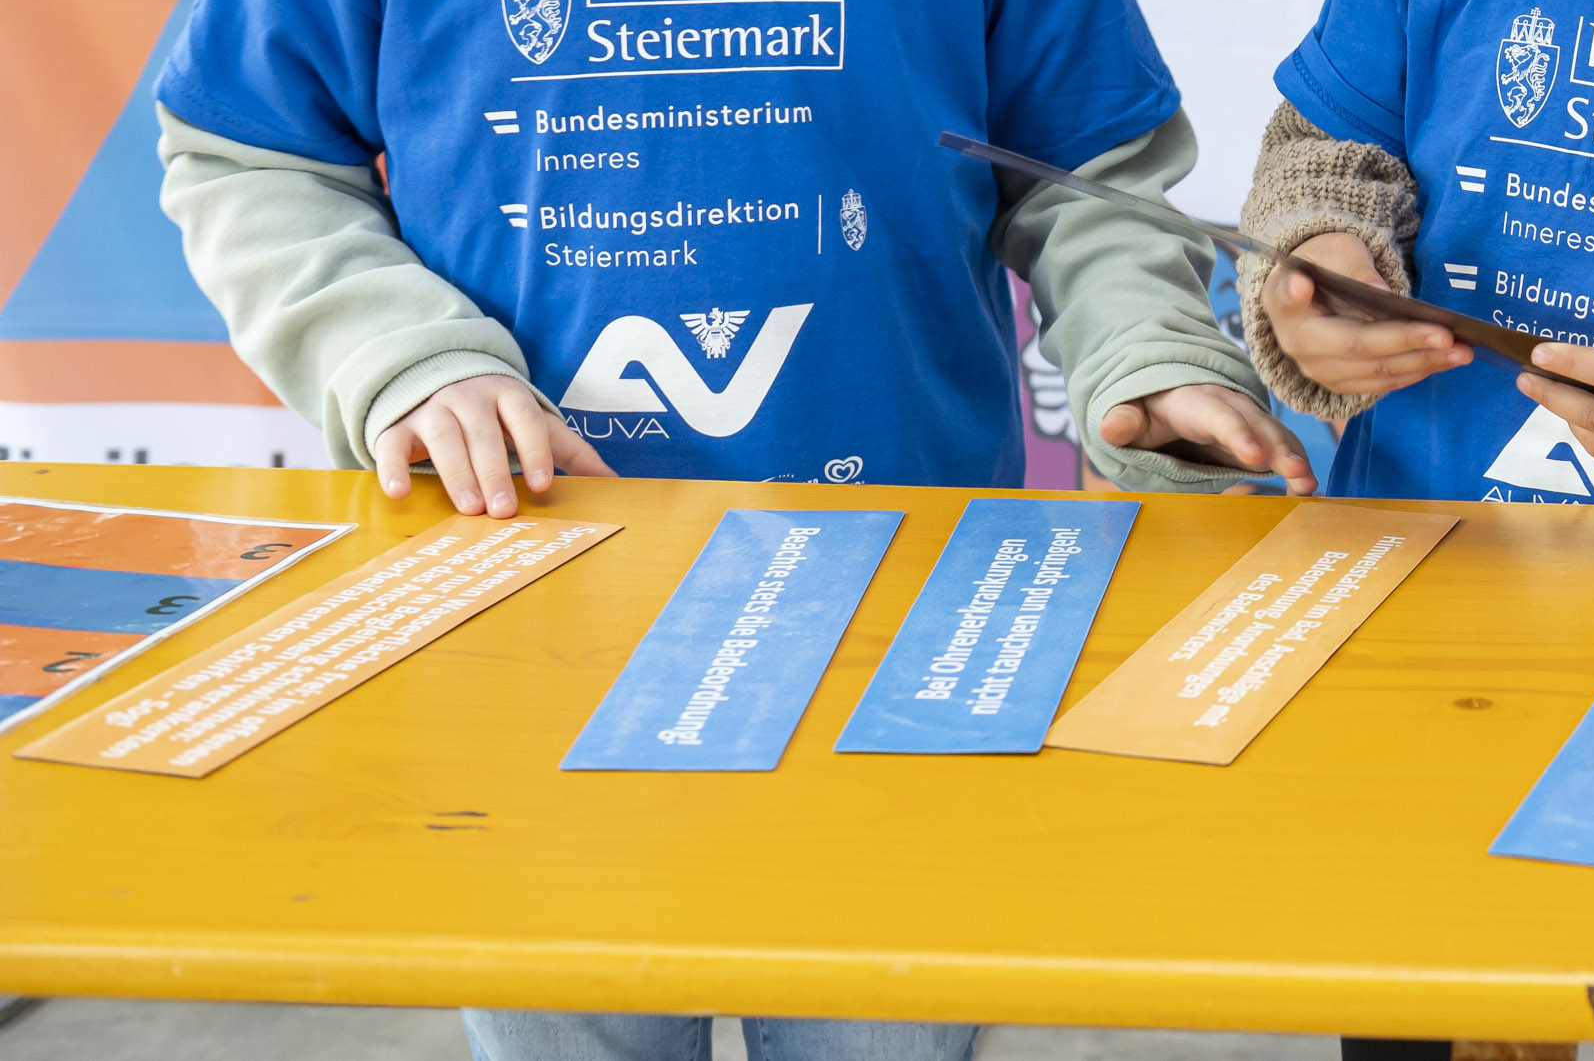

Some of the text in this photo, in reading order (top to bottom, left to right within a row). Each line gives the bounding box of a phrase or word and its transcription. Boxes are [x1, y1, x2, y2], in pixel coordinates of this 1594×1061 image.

[586, 14, 835, 62] Steiermark
[535, 102, 813, 134] Bundesministerium
[536, 148, 640, 171] Inneres
[539, 199, 799, 235] Bildungsdirektion
[545, 240, 698, 267] Steiermark
[566, 414, 670, 439] AUVA
[415, 535, 462, 556] und
[442, 522, 538, 564] Vermeide
[466, 539, 543, 574] Wasser
[505, 526, 596, 567] Sprünge,
[410, 565, 454, 583] das
[432, 574, 474, 593] nur
[458, 569, 520, 597] wenn
[1246, 573, 1283, 591] des
[1319, 535, 1405, 603] Hinweistafeln
[259, 556, 426, 642] vorbeifahrenden
[407, 593, 446, 604] in
[1303, 604, 1339, 618] im
[274, 582, 422, 661] Anschwimmen
[297, 605, 422, 665] Begleitung
[332, 598, 475, 671] Wasserfläche
[656, 527, 821, 745] Beachte stets die Badeordnung!
[913, 538, 1029, 699] Bei Ohrenerkrankungen
[965, 527, 1081, 713] nicht tauchen und springen!
[172, 642, 272, 690] Schiffen
[233, 660, 285, 683] von
[1177, 620, 1275, 698] Anordnungen
[1216, 643, 1295, 704] Anschläge
[256, 697, 305, 715] im
